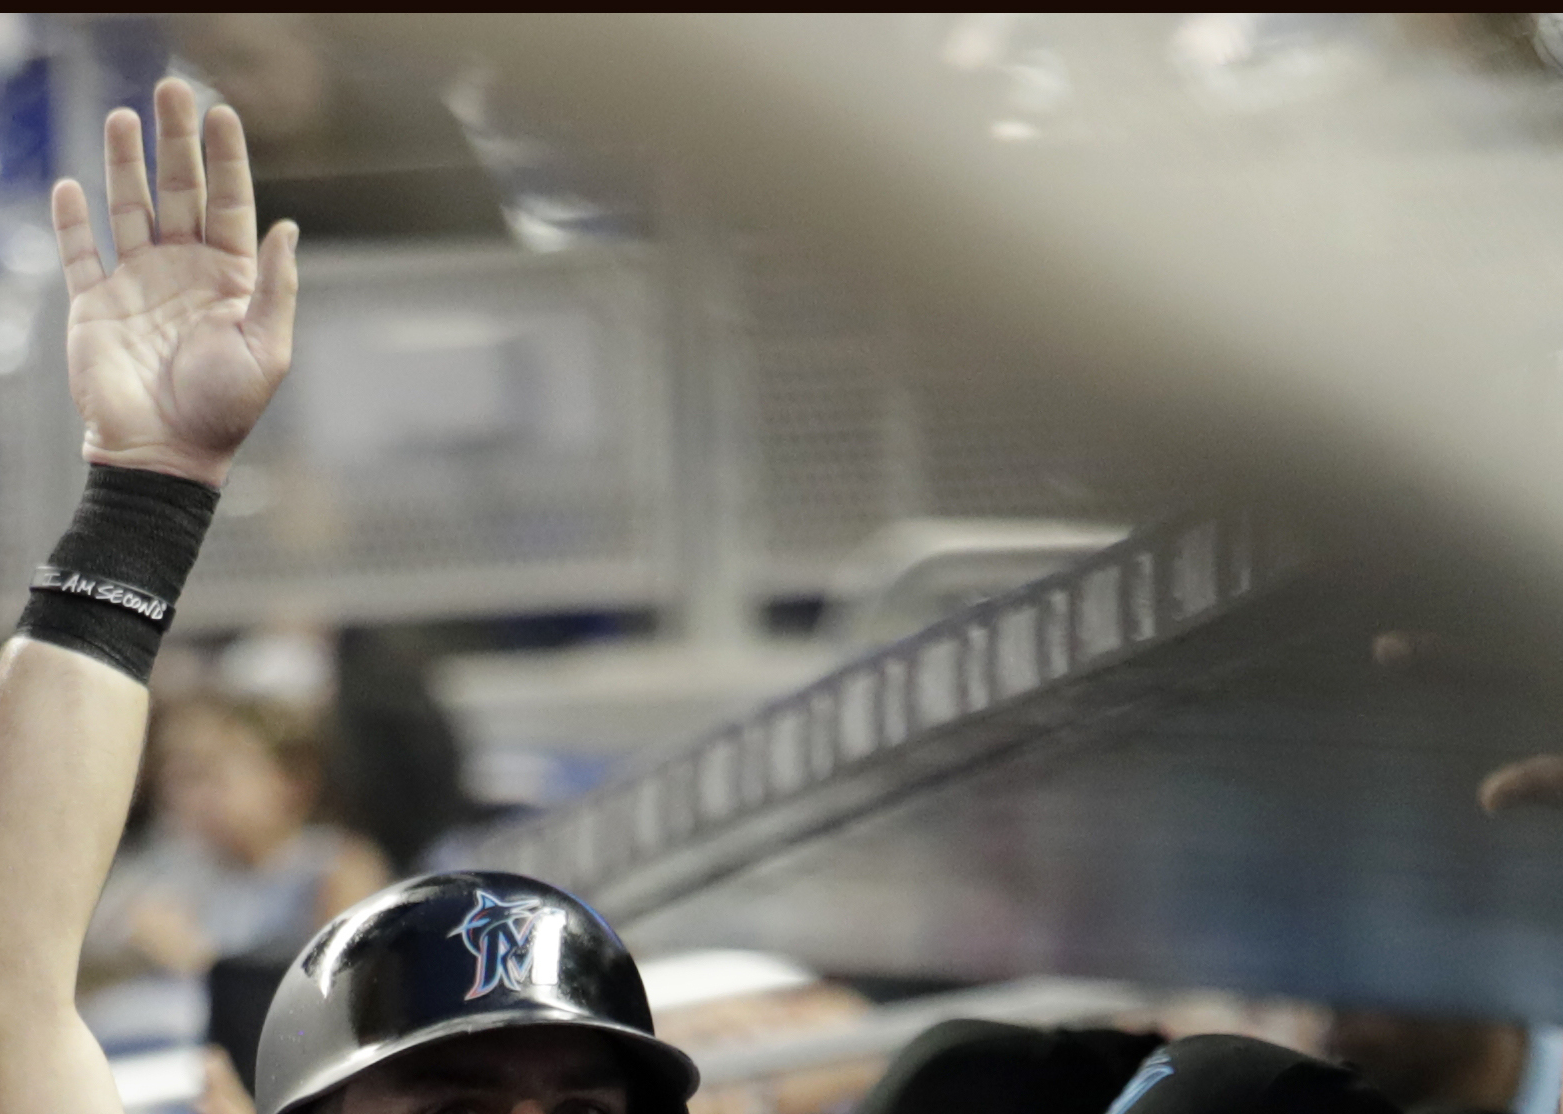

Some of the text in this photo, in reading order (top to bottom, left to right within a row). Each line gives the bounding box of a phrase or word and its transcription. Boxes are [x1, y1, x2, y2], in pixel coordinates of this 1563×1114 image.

[41, 572, 167, 620] I AM SECOND
